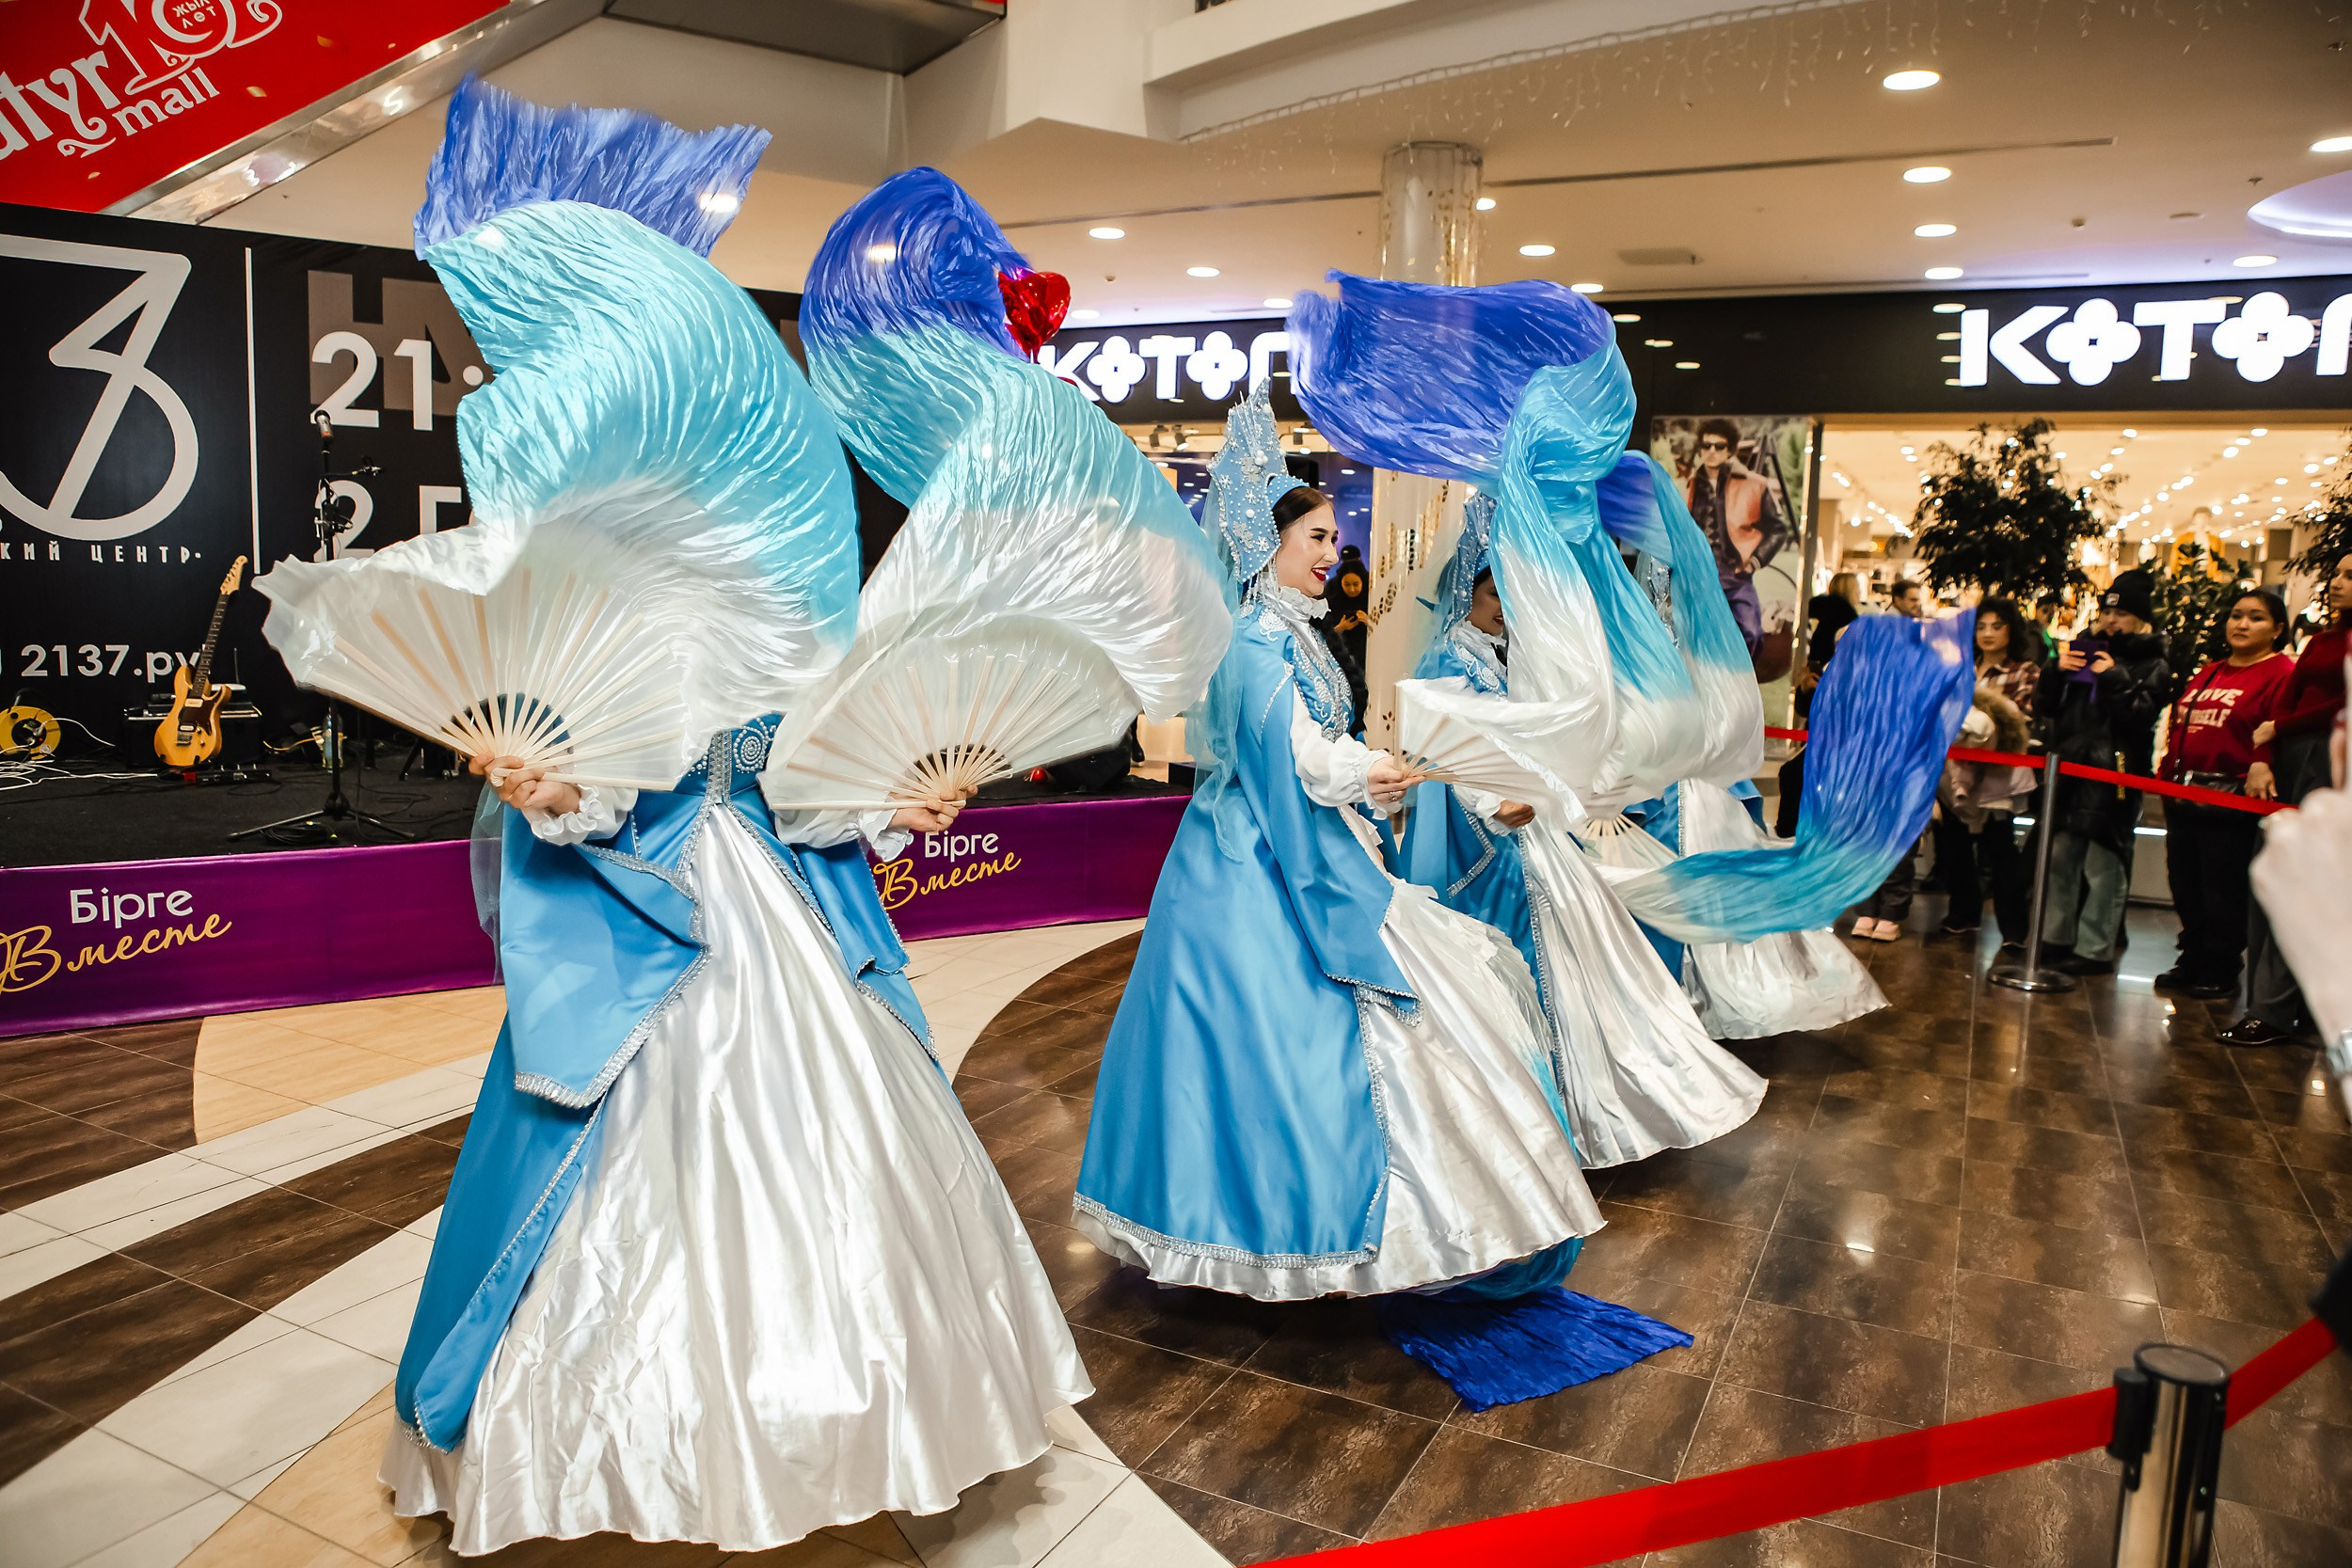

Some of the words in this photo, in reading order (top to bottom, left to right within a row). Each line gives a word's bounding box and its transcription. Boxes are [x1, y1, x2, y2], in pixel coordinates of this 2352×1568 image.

[112, 66, 220, 136] mall
[925, 830, 999, 863] Бірге
[70, 886, 194, 929] Бірге
[873, 851, 1022, 911] Вместе
[0, 913, 232, 995] Вместе
